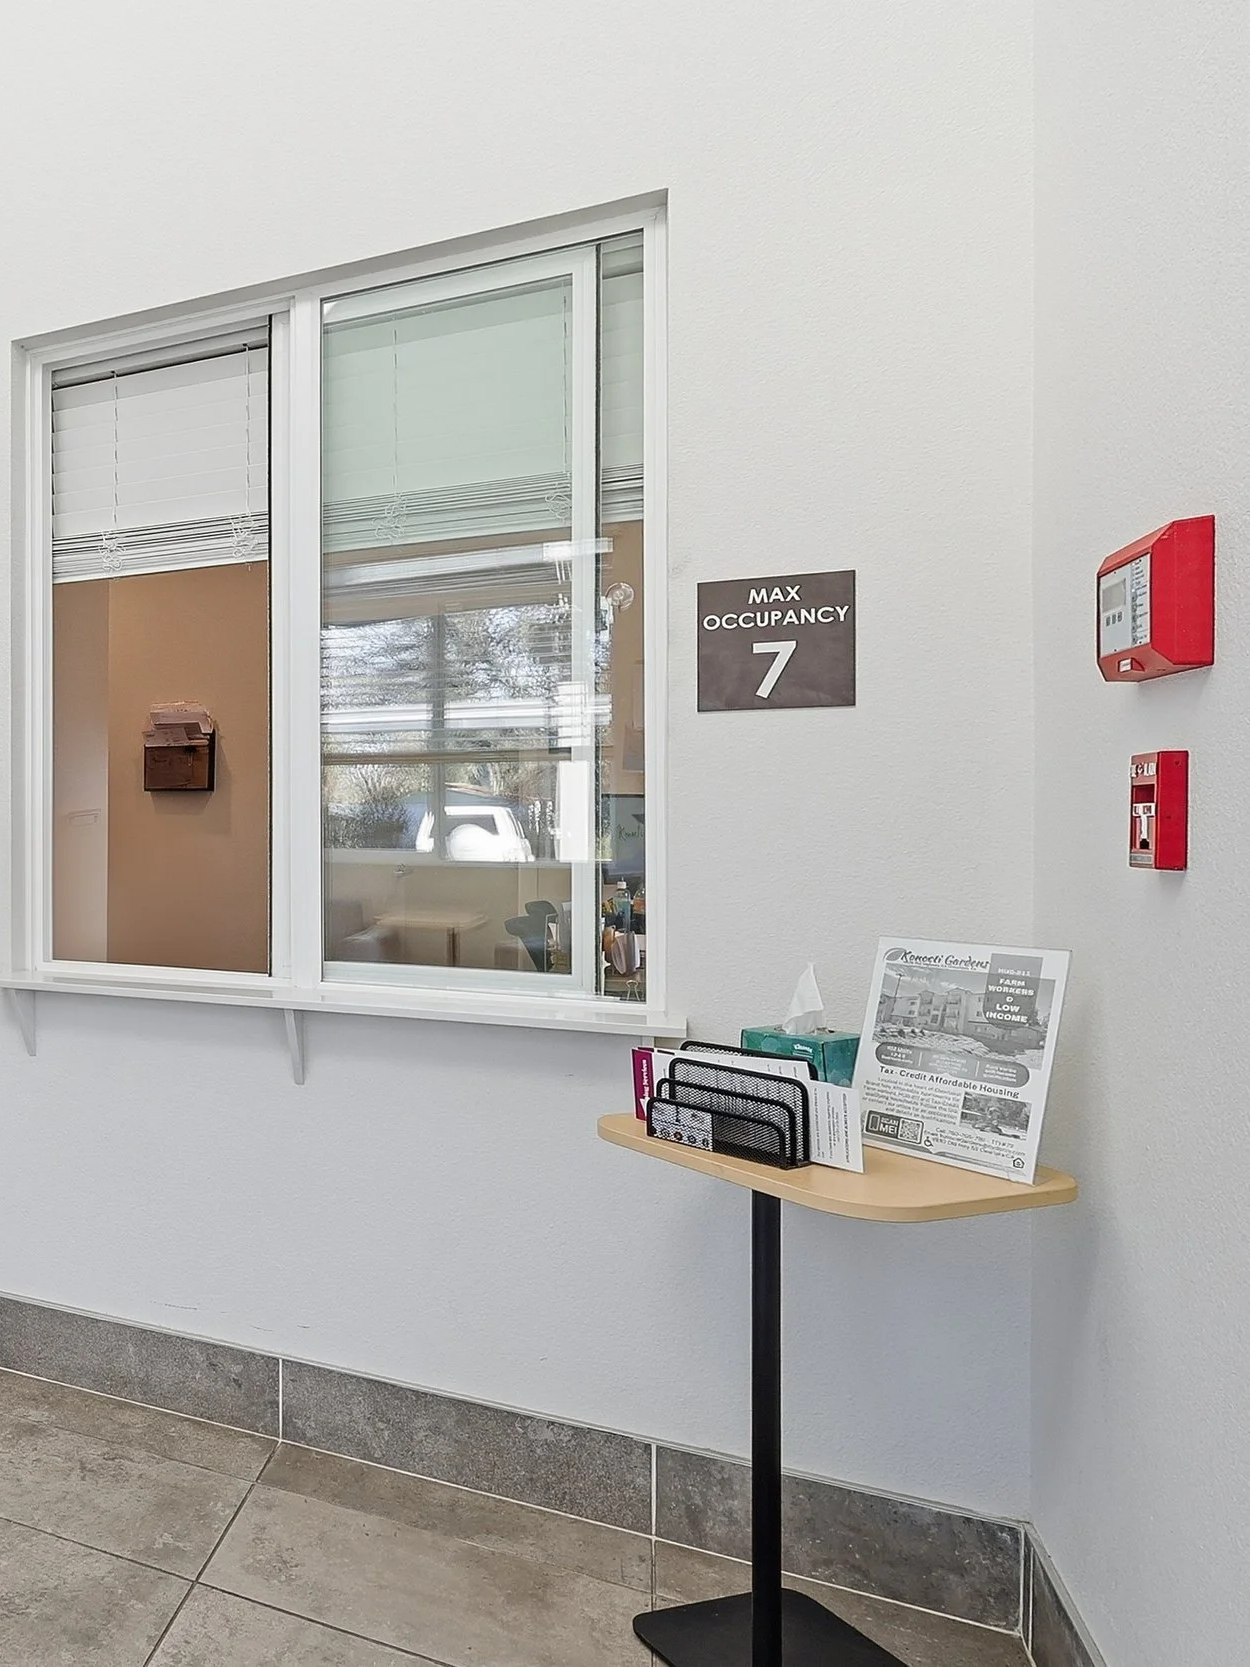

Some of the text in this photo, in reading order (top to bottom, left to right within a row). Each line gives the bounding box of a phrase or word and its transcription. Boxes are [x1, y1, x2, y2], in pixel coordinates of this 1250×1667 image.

[748, 585, 801, 605] MAX
[703, 605, 850, 630] OCCUPANCY
[752, 640, 797, 699] 7
[944, 954, 990, 969] Gardens
[1000, 978, 1025, 986] FARM
[988, 984, 1034, 996] WORKERS
[996, 1003, 1020, 1012] LOW
[986, 1011, 1028, 1023] INCOME
[899, 1070, 926, 1081] Credit
[928, 1075, 978, 1091] Affordable
[979, 1084, 1020, 1099] Housing
